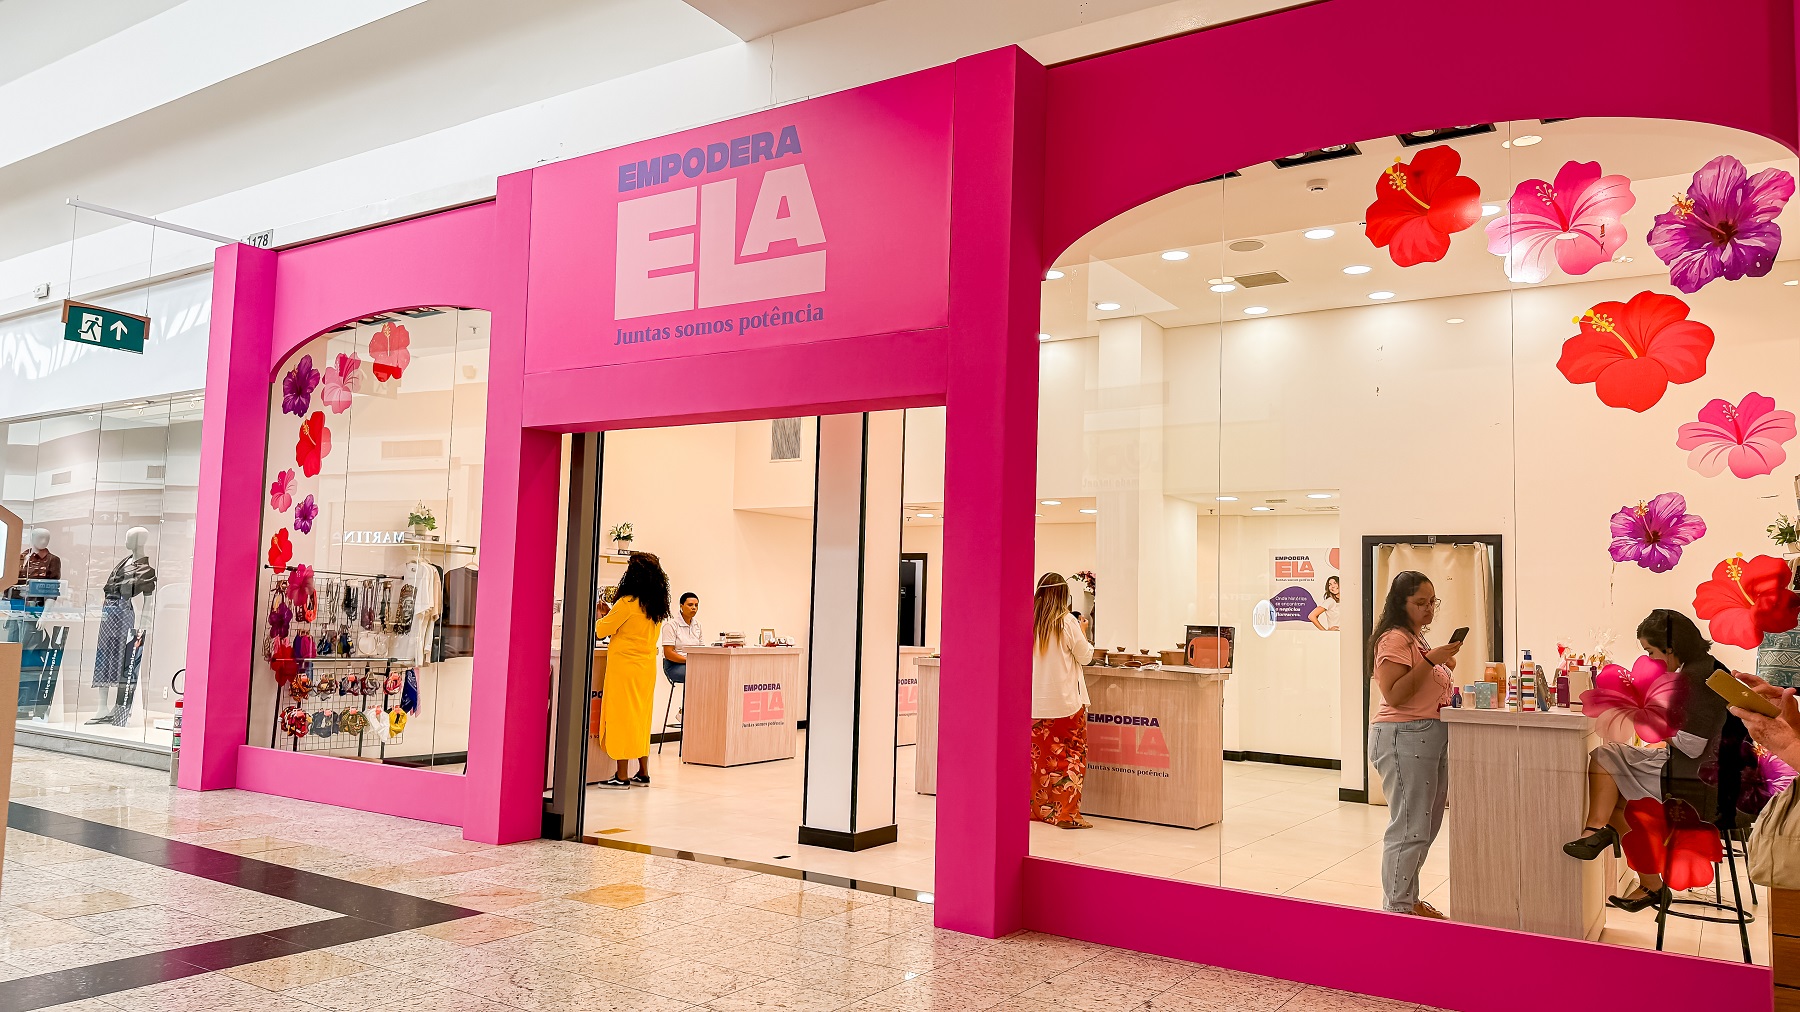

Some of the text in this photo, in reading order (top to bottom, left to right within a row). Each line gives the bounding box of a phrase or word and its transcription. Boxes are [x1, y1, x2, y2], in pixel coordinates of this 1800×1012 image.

[618, 124, 802, 193] EMPODERA
[614, 163, 827, 321] ELA
[614, 304, 825, 346] Juntas somos potência
[1275, 561, 1315, 578] ELA
[743, 683, 781, 691] EMPODERA
[743, 691, 784, 722] ELA
[1087, 713, 1160, 727] EMPODERA
[1087, 724, 1170, 768] ELA
[1087, 763, 1110, 771] Juntas
[1137, 769, 1169, 778] potência
